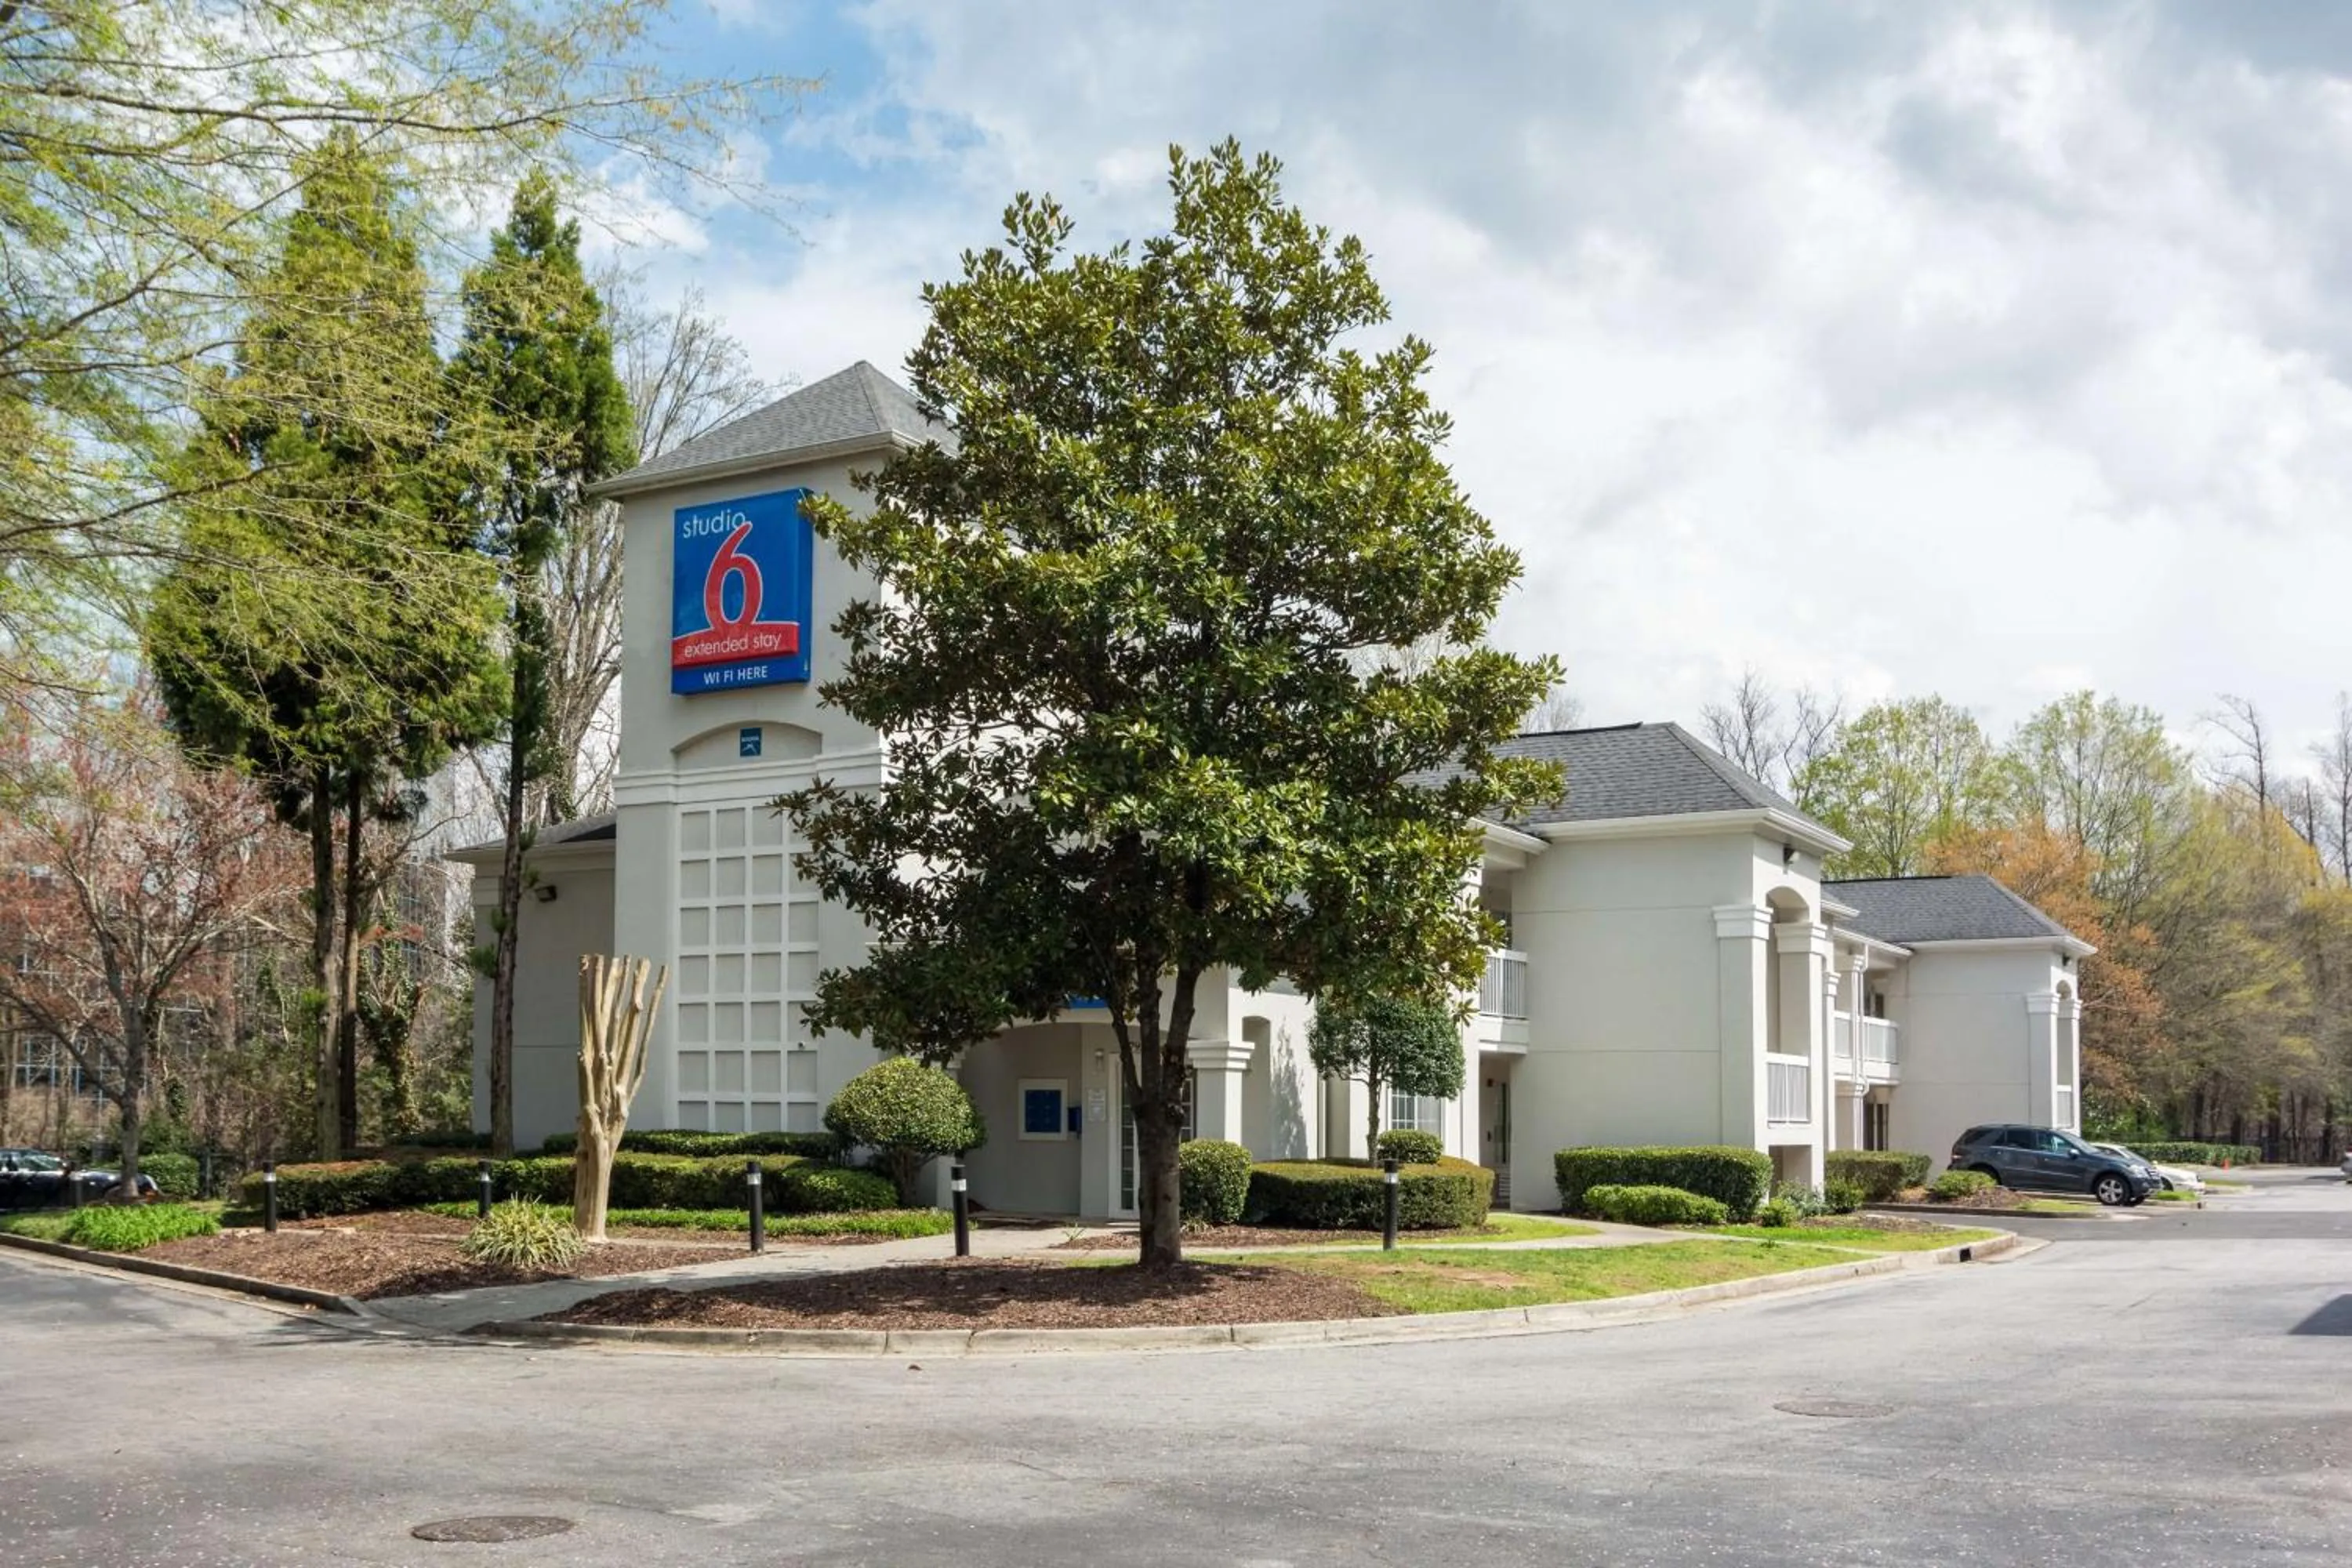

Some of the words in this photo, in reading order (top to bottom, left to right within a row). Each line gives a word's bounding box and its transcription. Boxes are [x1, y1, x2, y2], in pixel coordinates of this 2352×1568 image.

[683, 508, 746, 538] studio
[704, 521, 764, 627] 6
[684, 633, 749, 658] extended
[753, 632, 782, 651] stay
[703, 671, 720, 684] WI
[724, 670, 734, 683] FI
[738, 666, 768, 681] HERE
